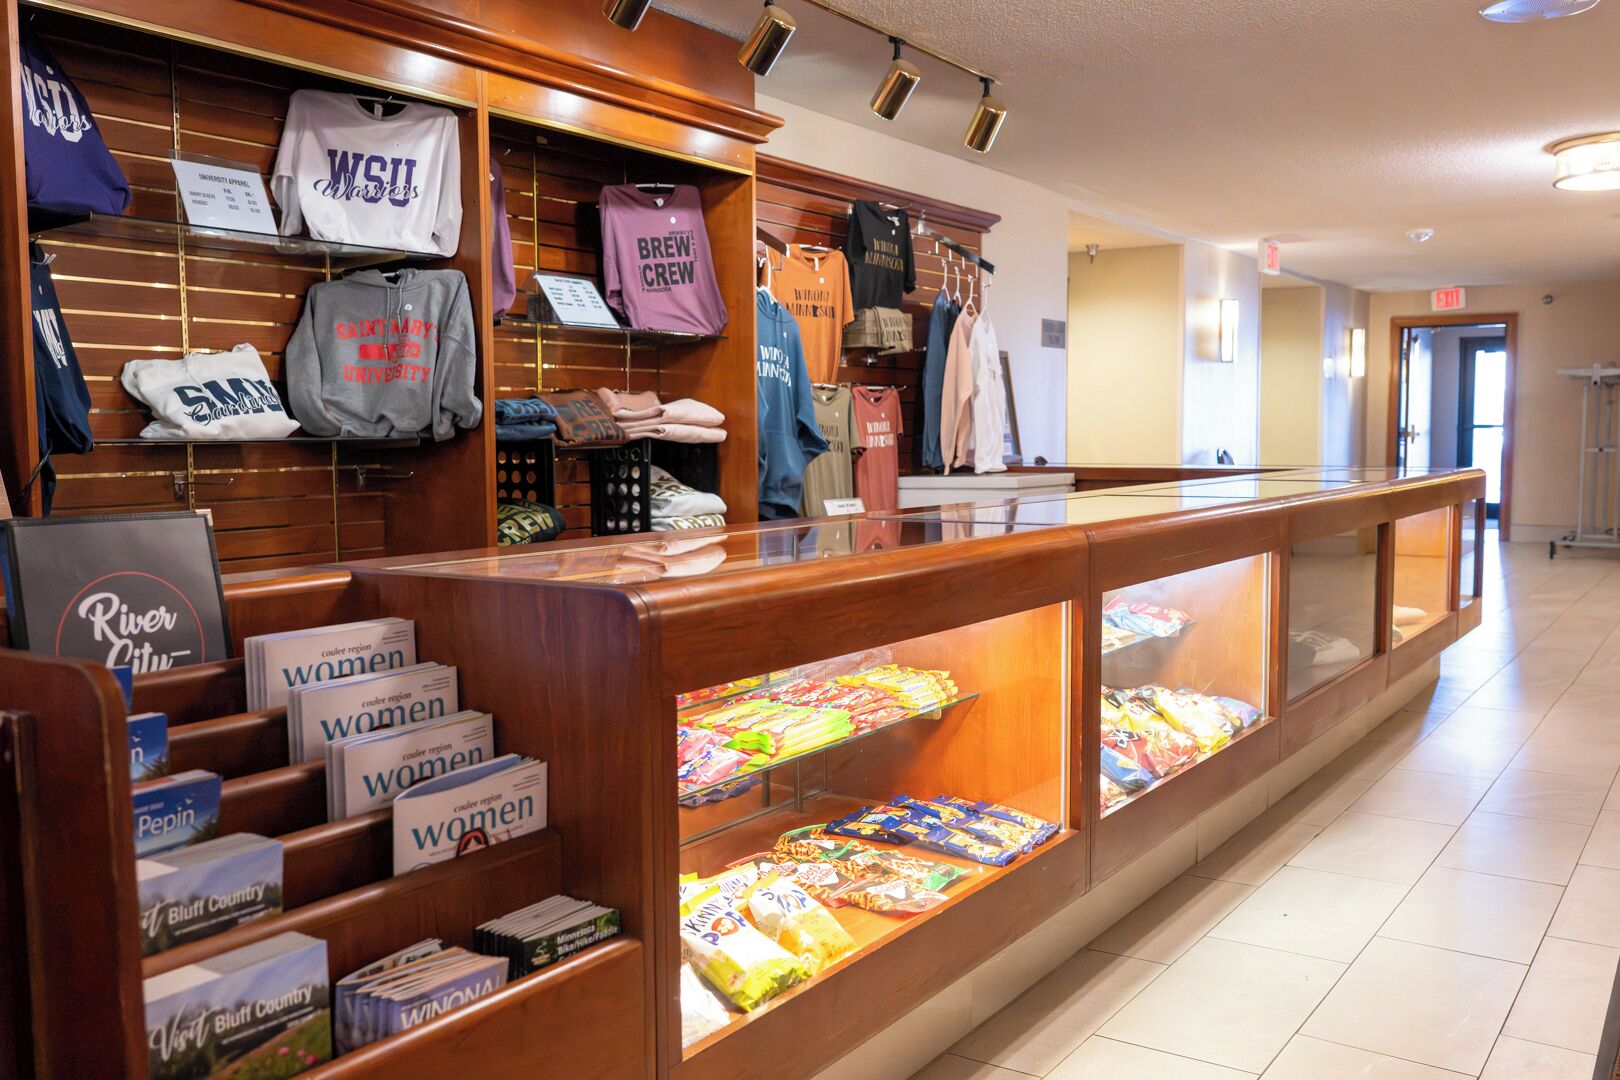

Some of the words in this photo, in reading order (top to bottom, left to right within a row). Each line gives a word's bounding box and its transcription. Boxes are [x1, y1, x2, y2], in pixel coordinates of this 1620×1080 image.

[313, 172, 420, 200] Warriors
[327, 148, 417, 207] WSU
[637, 235, 690, 260] BREW
[642, 261, 694, 288] CREW
[1436, 288, 1460, 309] EXIT
[335, 318, 387, 340] SAINT
[78, 592, 177, 641] River
[282, 648, 404, 688] women
[321, 646, 346, 658] coulee
[347, 643, 372, 654] region
[387, 691, 412, 703] region
[320, 696, 445, 741] women
[362, 746, 483, 797] women
[138, 806, 195, 838] Pepin
[411, 795, 534, 851] women
[167, 899, 206, 926] Bluff
[207, 882, 267, 912] Country
[214, 1005, 252, 1034] Bluff
[255, 984, 313, 1018] Country
